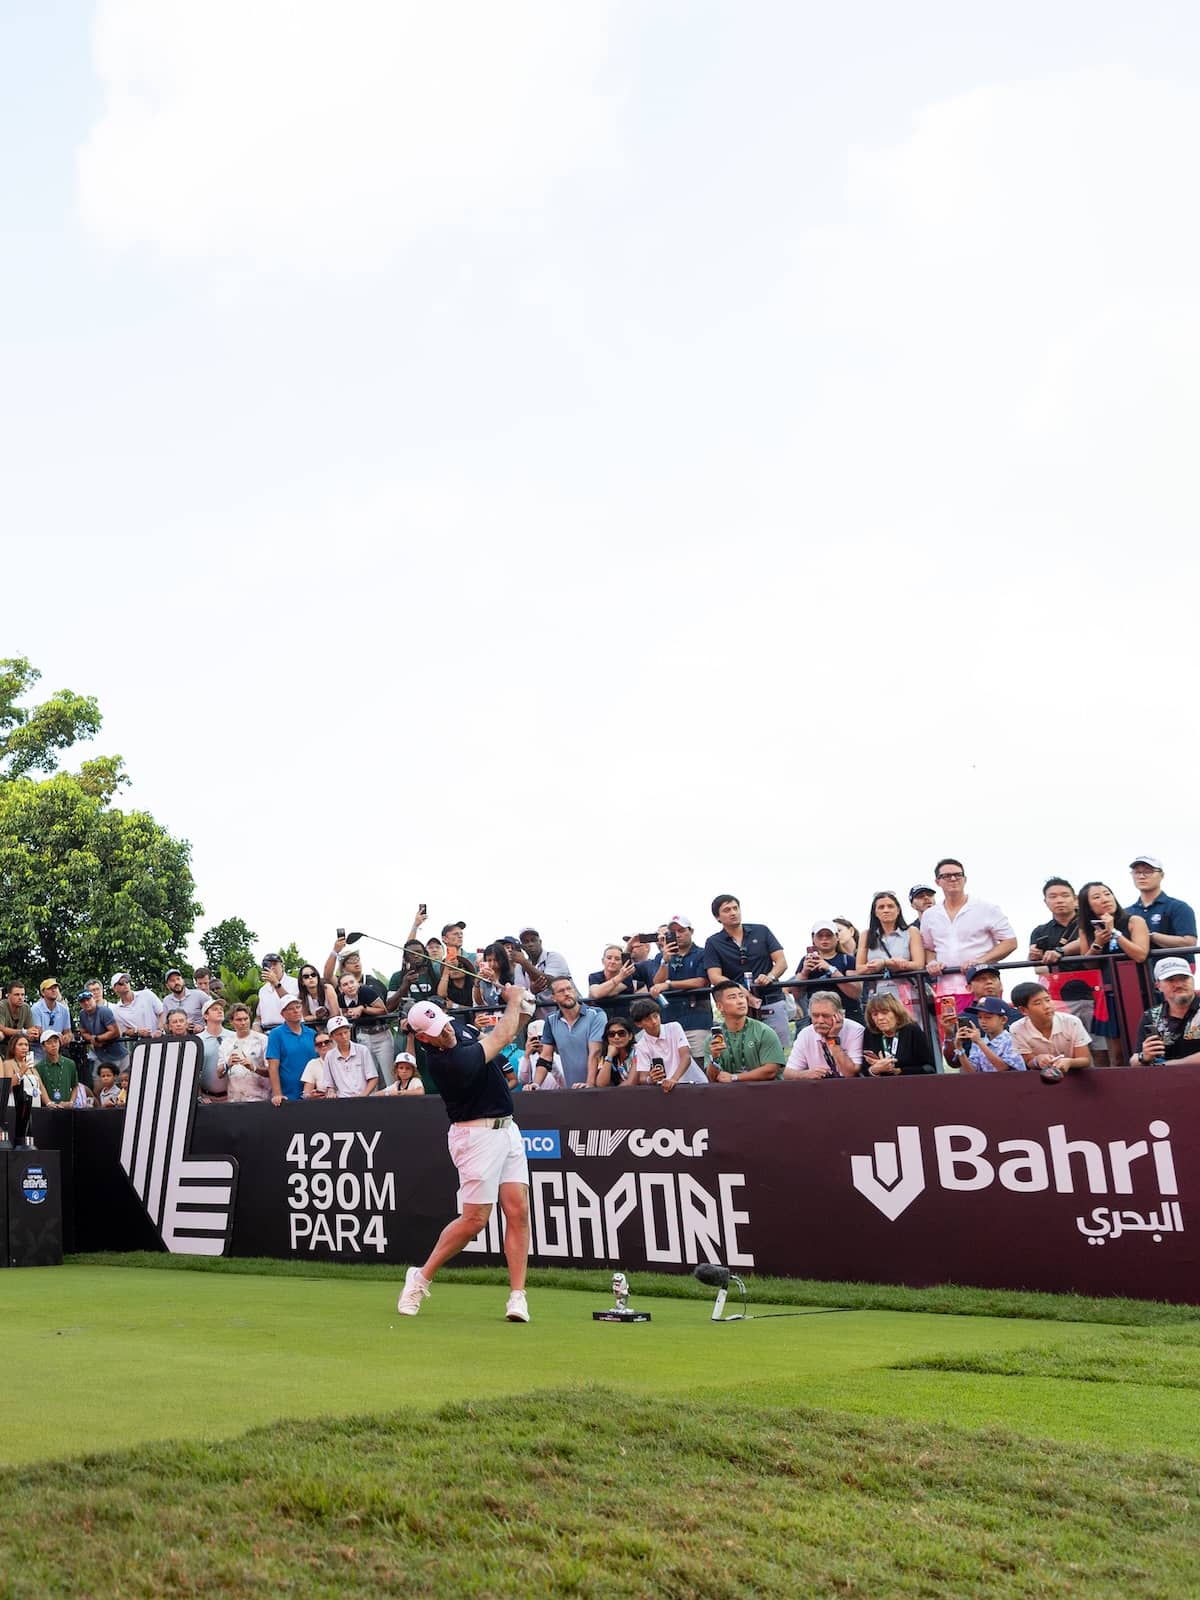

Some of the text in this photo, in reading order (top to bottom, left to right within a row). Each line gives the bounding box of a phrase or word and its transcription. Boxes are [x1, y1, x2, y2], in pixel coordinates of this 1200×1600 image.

[286, 1131, 382, 1170] 427Y
[567, 1128, 709, 1158] LIV GOLF
[933, 1119, 1179, 1196] Bahri
[287, 1173, 396, 1211] 390M
[1076, 1201, 1185, 1246] البحري
